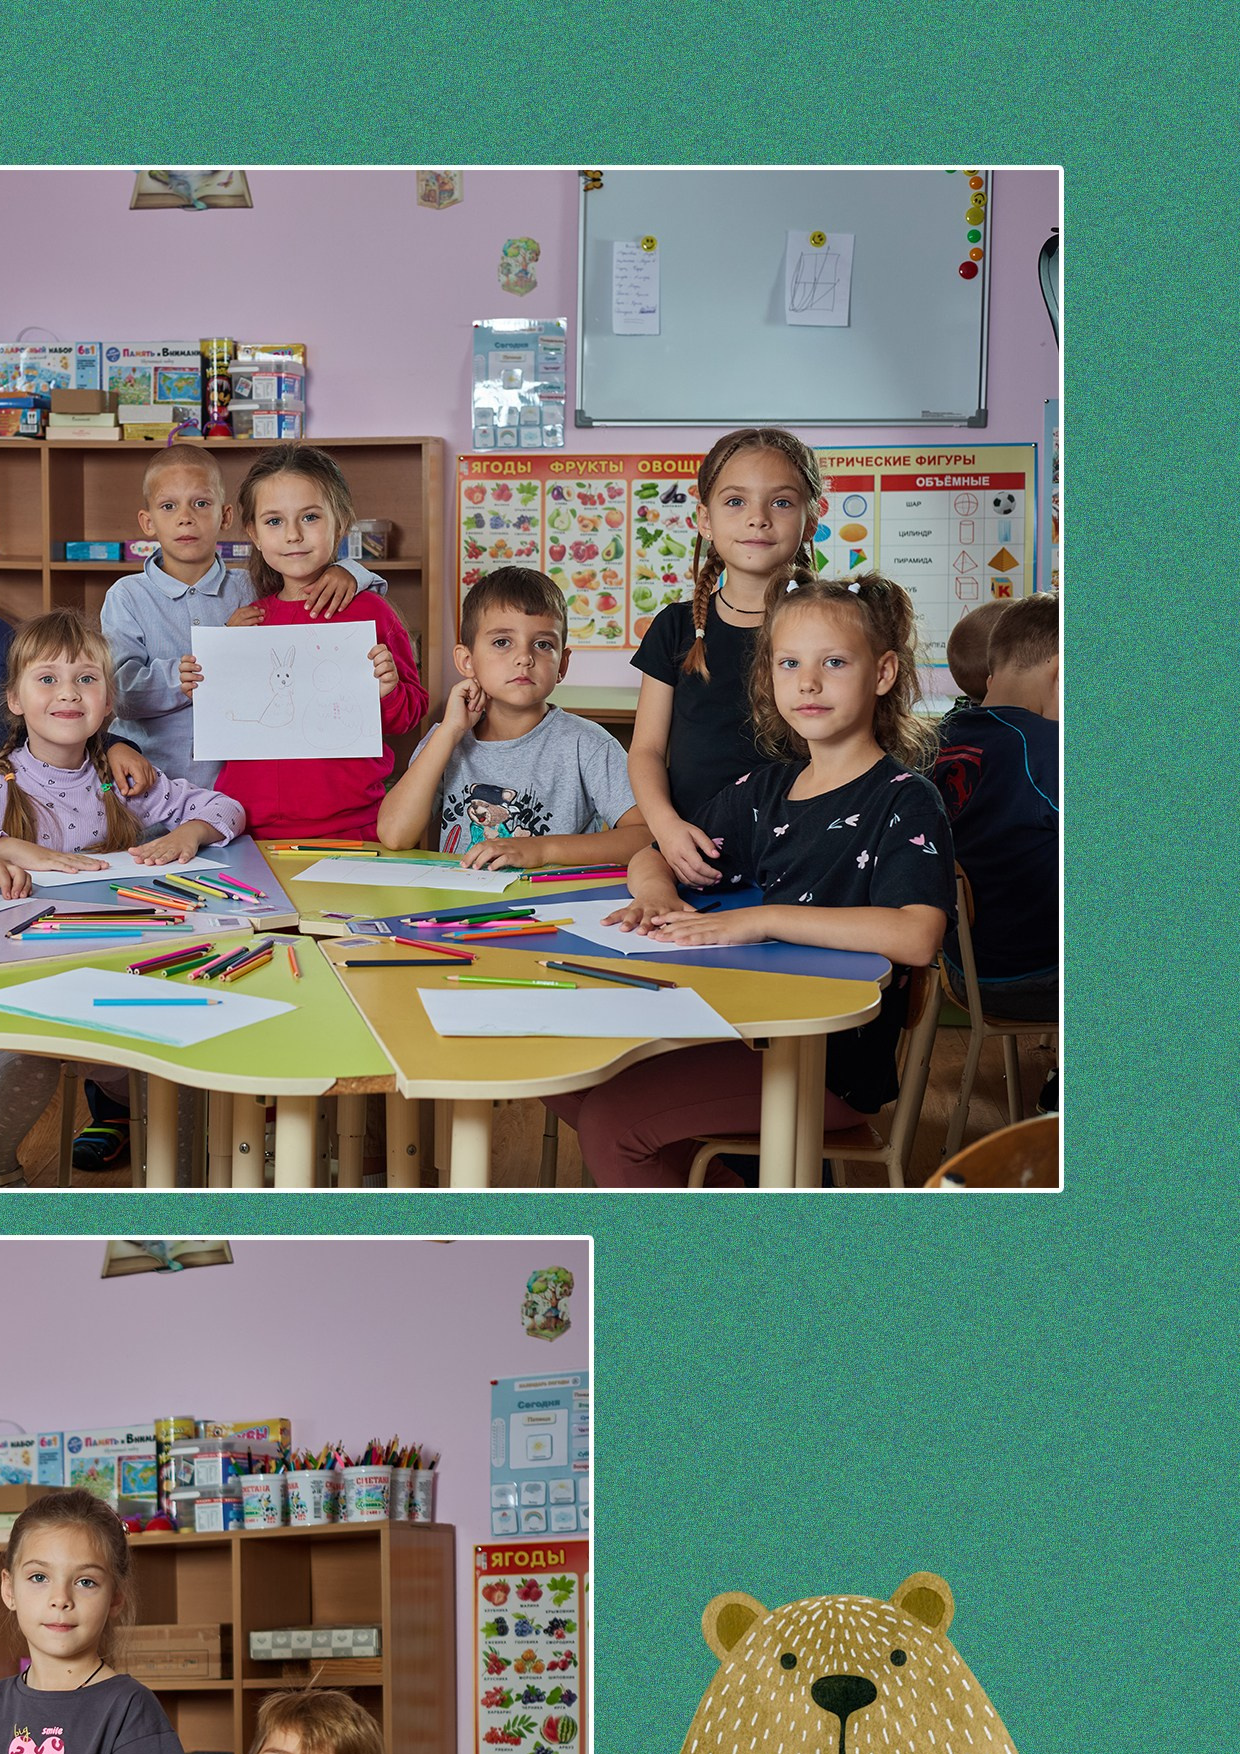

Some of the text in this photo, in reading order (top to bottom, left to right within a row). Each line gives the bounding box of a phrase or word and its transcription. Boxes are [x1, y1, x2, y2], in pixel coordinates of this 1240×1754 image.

[162, 348, 201, 358] ВНИМАНИ
[472, 460, 532, 475] ЯГОДЫ
[549, 460, 624, 475] ФРУКТЫ
[819, 454, 976, 468] ЕТРИЧЕСКИЕ ФИГУРЫ
[916, 474, 990, 488] ОБЪЁМНЫЕ
[898, 530, 932, 538] ЦИЛИНДР
[998, 585, 1011, 598] К
[518, 1400, 560, 1410] Сегодня
[492, 1550, 565, 1568] ЯГОДЫ
[14, 1724, 30, 1742] big
[42, 1726, 64, 1736] smile
